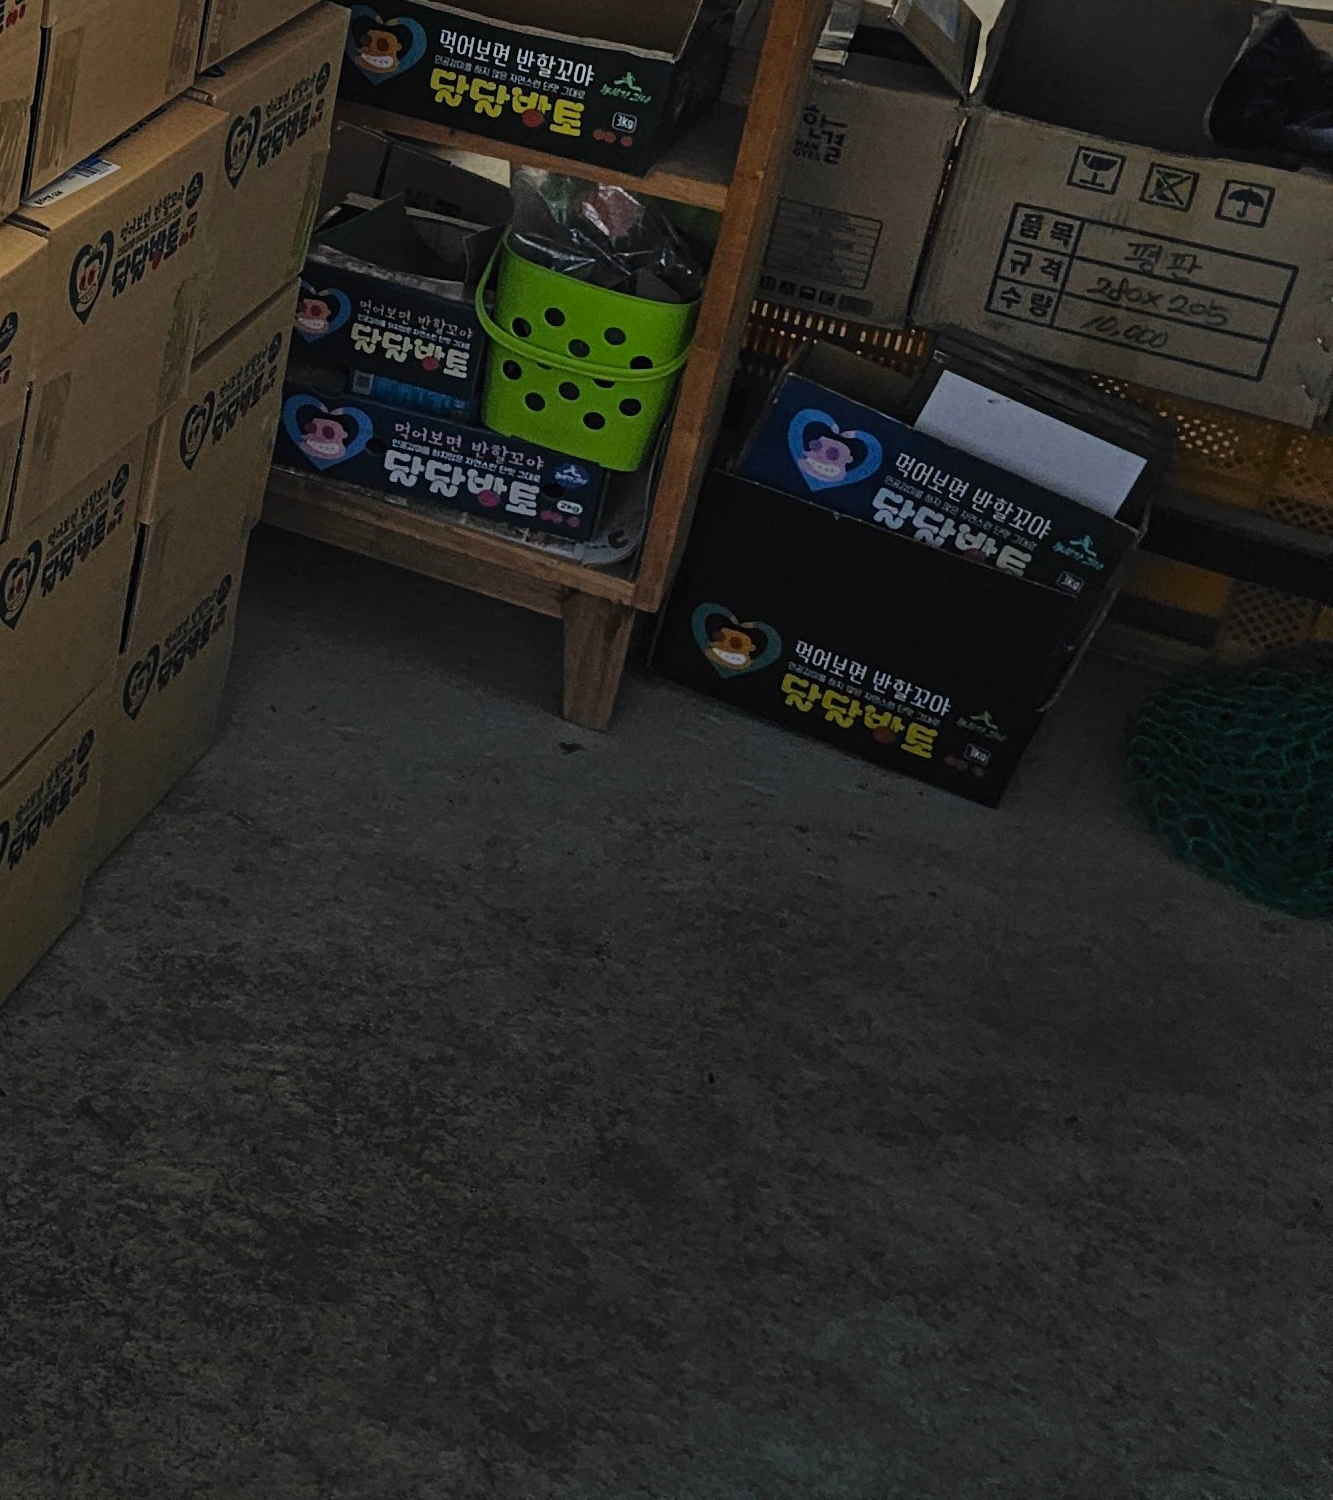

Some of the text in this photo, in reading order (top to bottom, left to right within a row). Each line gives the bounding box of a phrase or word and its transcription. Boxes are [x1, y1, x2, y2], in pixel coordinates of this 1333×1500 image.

[439, 29, 595, 87] 먹어보면 반할꼬야
[430, 67, 585, 137] 달달방토
[350, 322, 470, 379] 달달방토
[359, 299, 474, 340] 먹어보면 반할꼬야
[394, 422, 546, 470] 먹어보면 반할꼬야
[383, 450, 541, 517] 달달방토
[895, 452, 1053, 541] 먹어보면 반할꼬야
[794, 640, 953, 718] 먹어보면 반할꼬야
[780, 672, 939, 758] 달달방토
